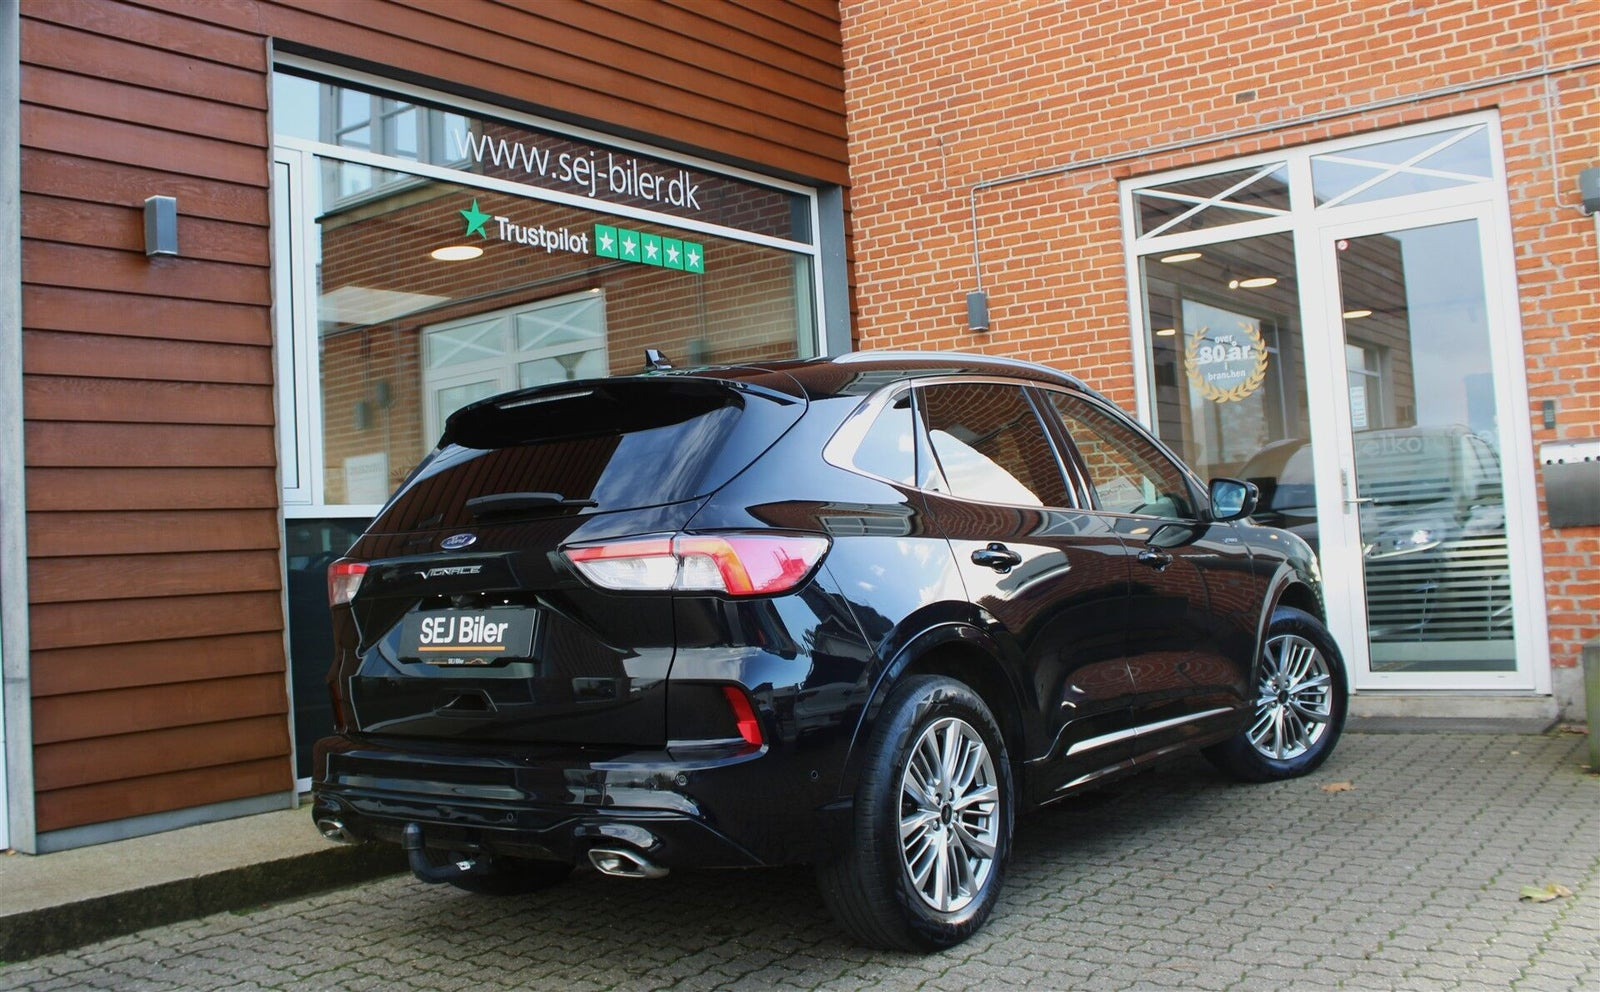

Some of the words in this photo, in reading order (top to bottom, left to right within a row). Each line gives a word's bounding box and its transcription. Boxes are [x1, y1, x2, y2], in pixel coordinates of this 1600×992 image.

[453, 128, 701, 211] www.sej-biler.dk
[494, 215, 590, 255] Trustpilot
[1215, 334, 1233, 343] over
[1200, 344, 1226, 363] 80
[414, 565, 482, 580] VIGNALE
[420, 616, 455, 644] SEJ
[458, 615, 508, 643] Biler
